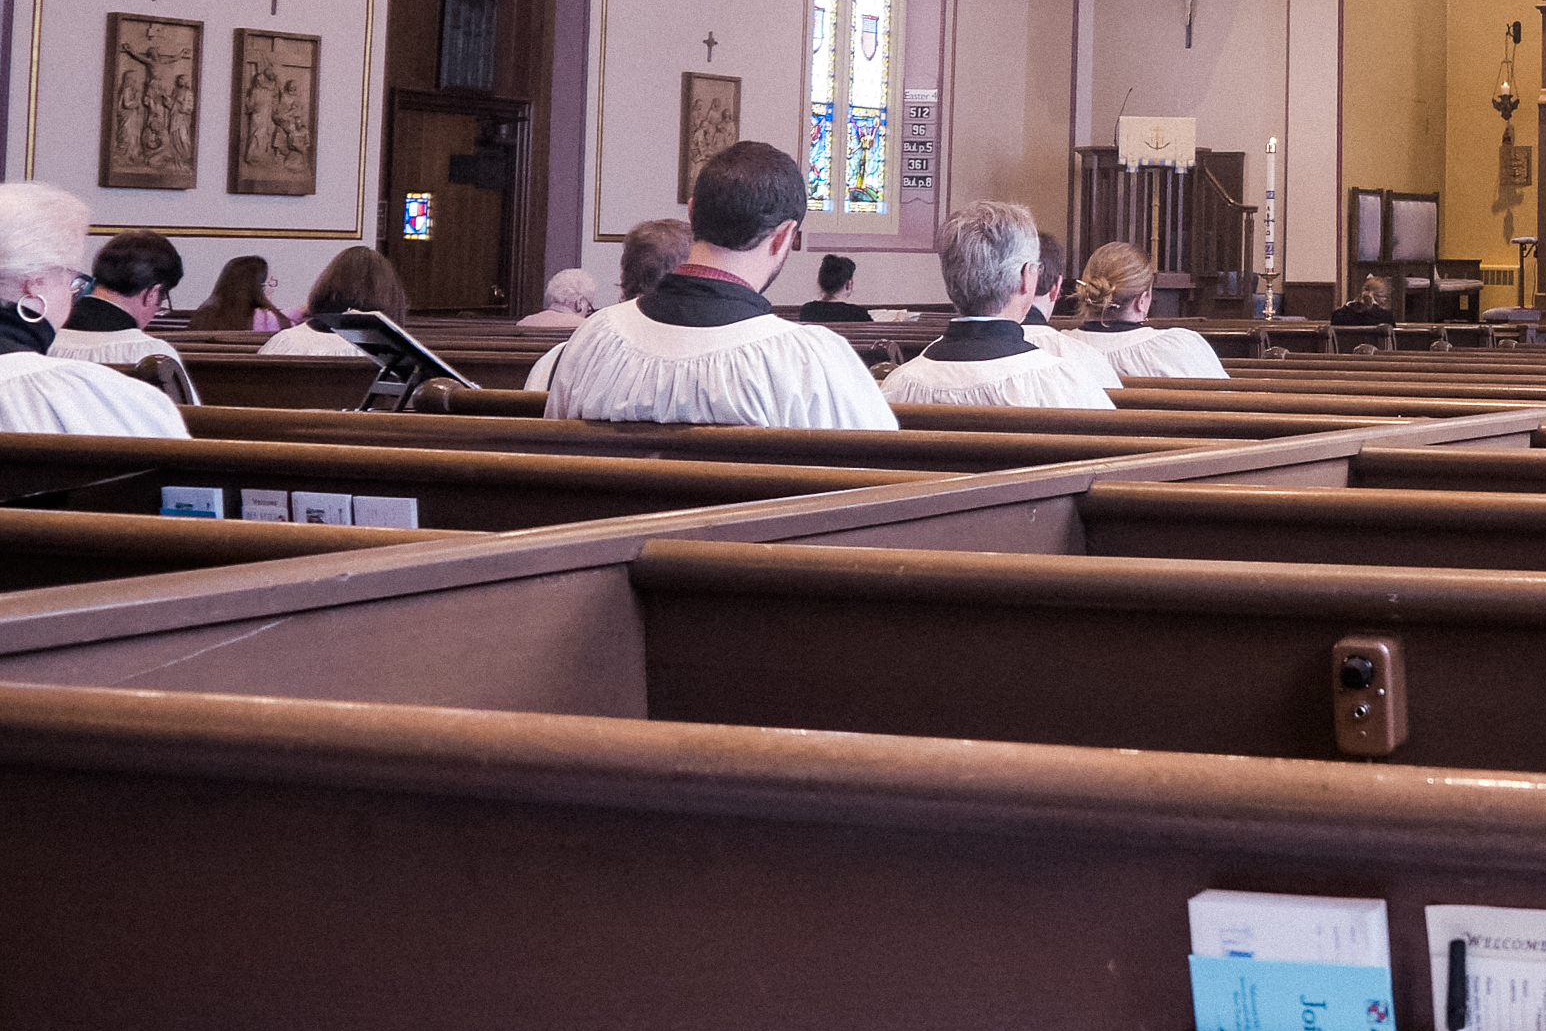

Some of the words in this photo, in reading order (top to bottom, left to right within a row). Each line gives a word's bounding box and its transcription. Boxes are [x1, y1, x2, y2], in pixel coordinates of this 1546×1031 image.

[904, 92, 929, 100] Easter
[932, 92, 937, 100] 4
[910, 108, 929, 118] 512
[912, 125, 925, 135] 96
[908, 160, 927, 170] 361
